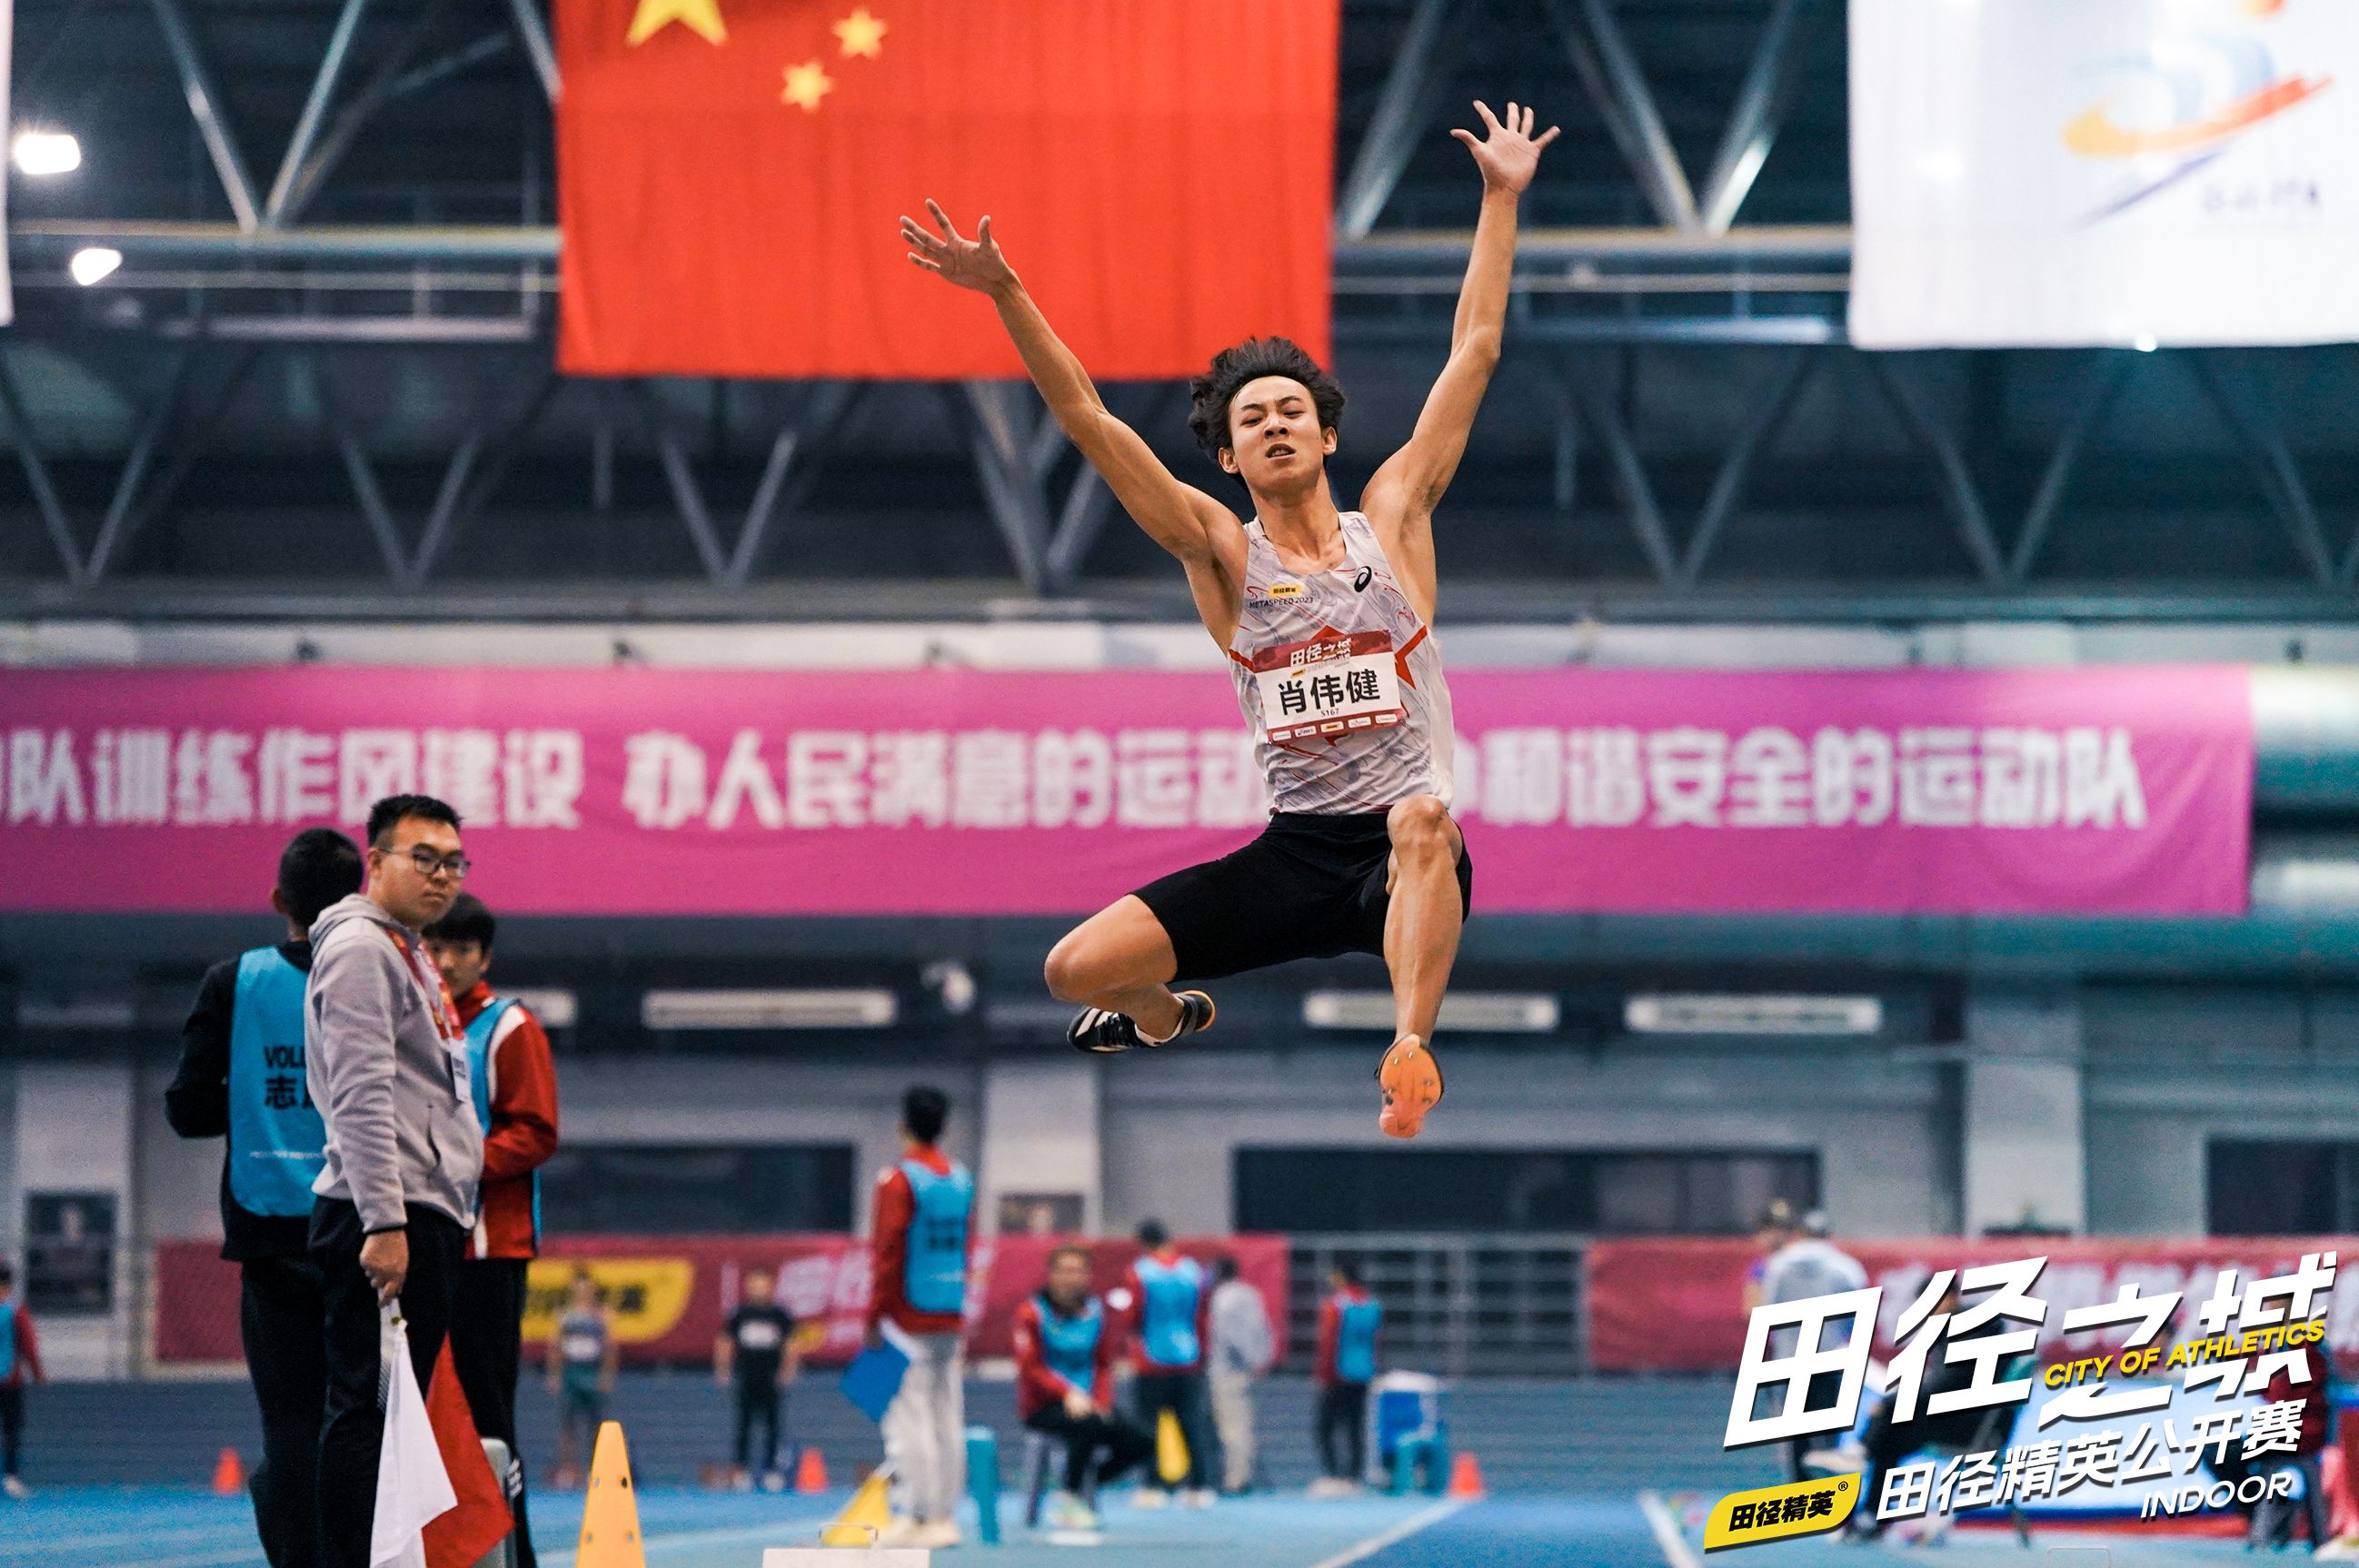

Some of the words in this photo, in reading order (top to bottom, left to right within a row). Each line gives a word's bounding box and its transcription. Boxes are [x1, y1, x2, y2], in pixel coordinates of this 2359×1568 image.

[1278, 669, 1380, 716] 肖伟健
[1320, 709, 1339, 718] 5167
[0, 728, 583, 826] 队训练作风建设
